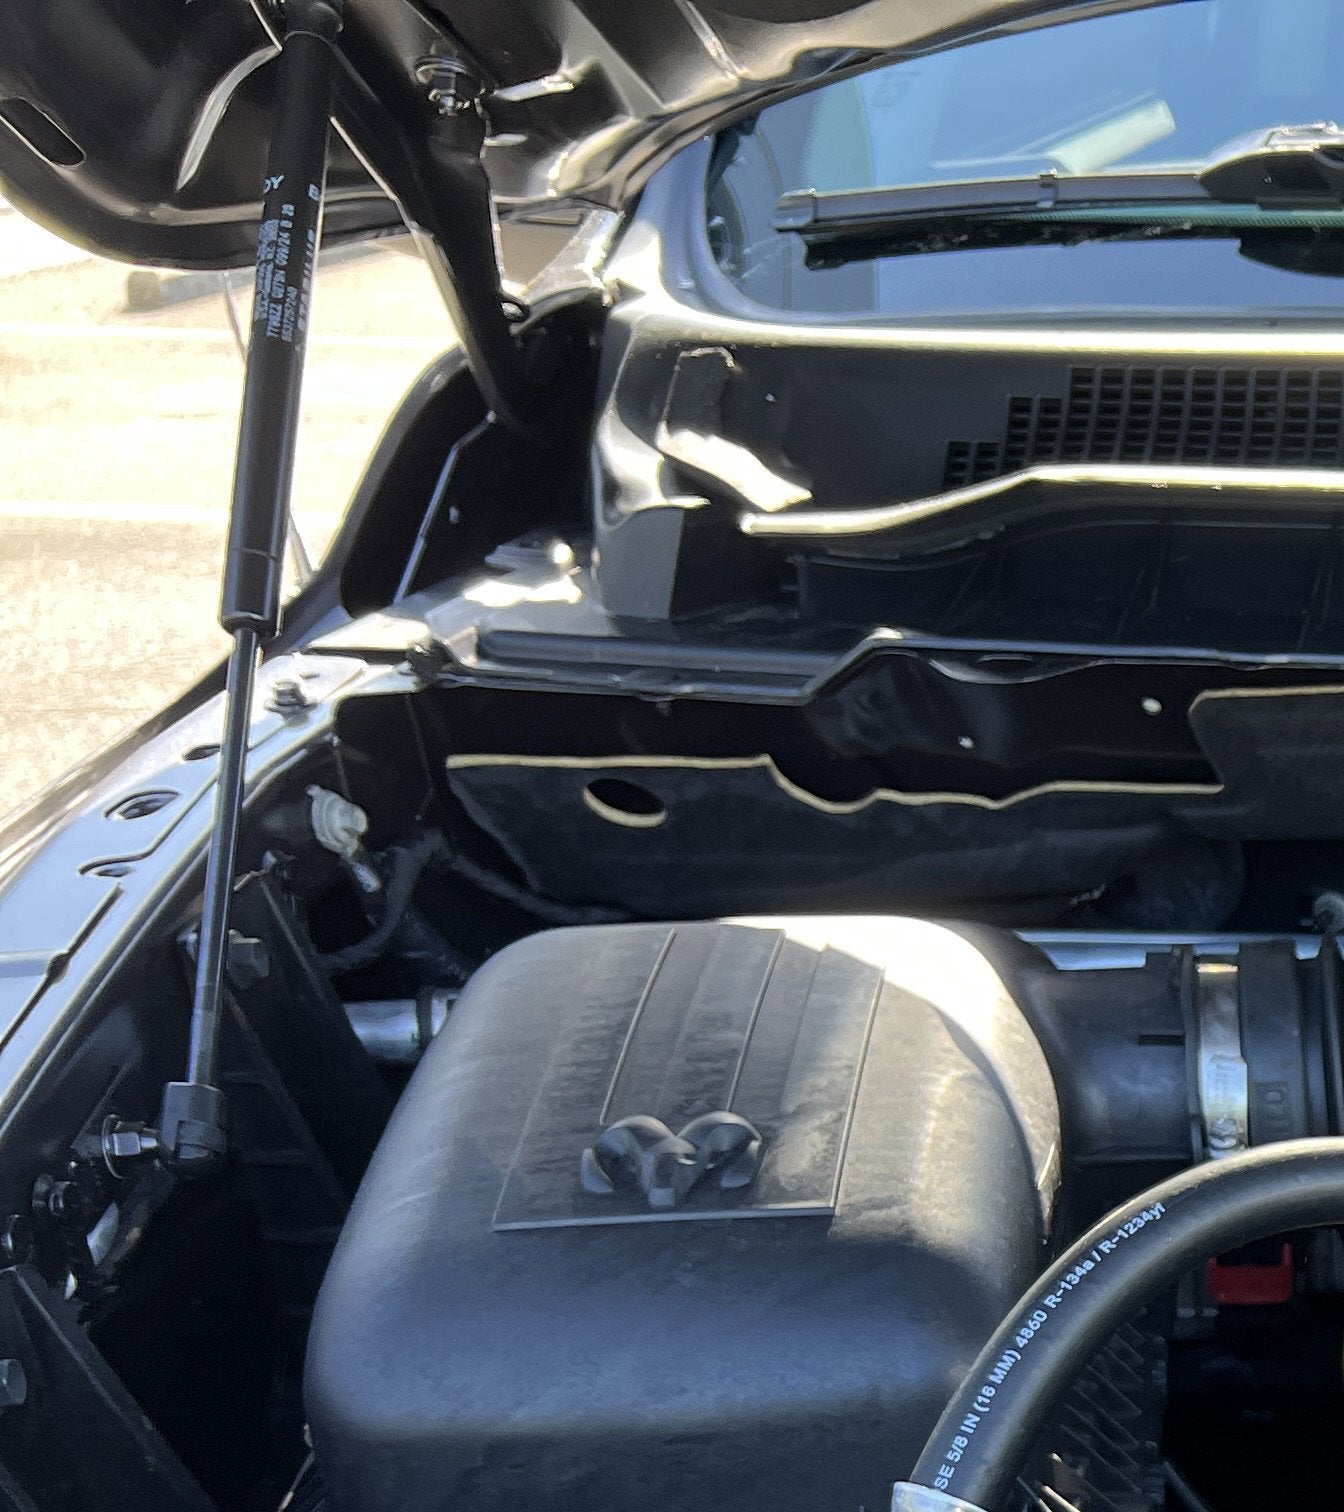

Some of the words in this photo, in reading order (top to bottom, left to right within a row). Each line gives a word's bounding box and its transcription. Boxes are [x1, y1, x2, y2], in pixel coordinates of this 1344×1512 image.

[947, 1434, 969, 1463] 5/8
[960, 1413, 981, 1434] IN
[973, 1384, 996, 1413] (16
[989, 1349, 1021, 1385] MM)
[1015, 1309, 1048, 1348] 4860
[1044, 1258, 1095, 1309] R-134a
[1098, 1201, 1166, 1254] R-1234yf
